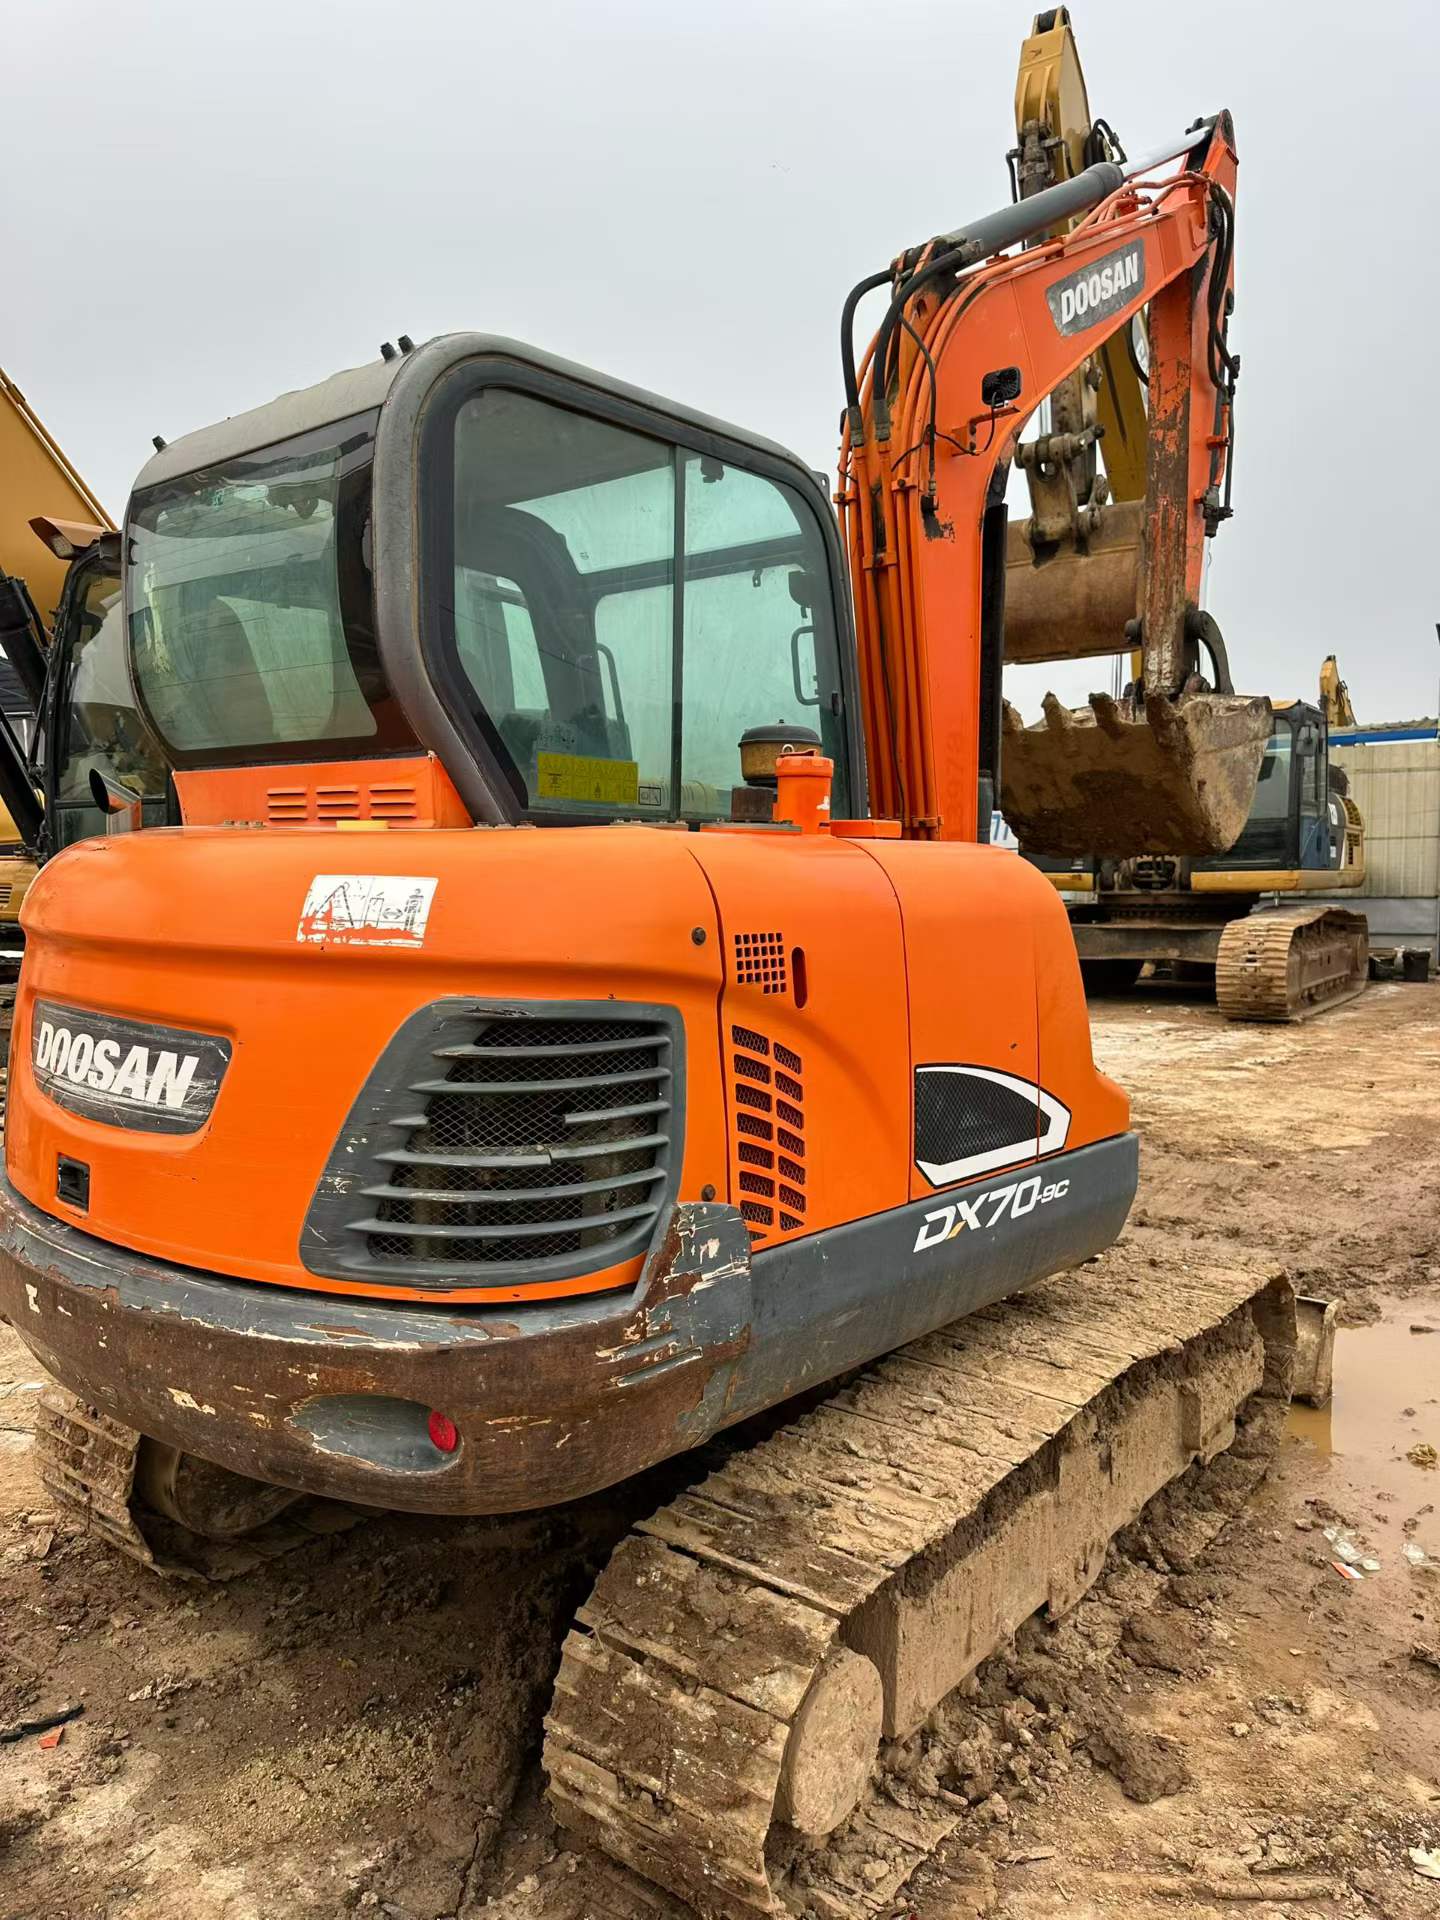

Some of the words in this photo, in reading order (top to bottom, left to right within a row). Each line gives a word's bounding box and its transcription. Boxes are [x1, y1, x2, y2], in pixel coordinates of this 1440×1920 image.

[1061, 252, 1138, 325] DOOSAN
[36, 1021, 200, 1109] DOOSAN
[913, 1175, 1070, 1253] DX70-9C
